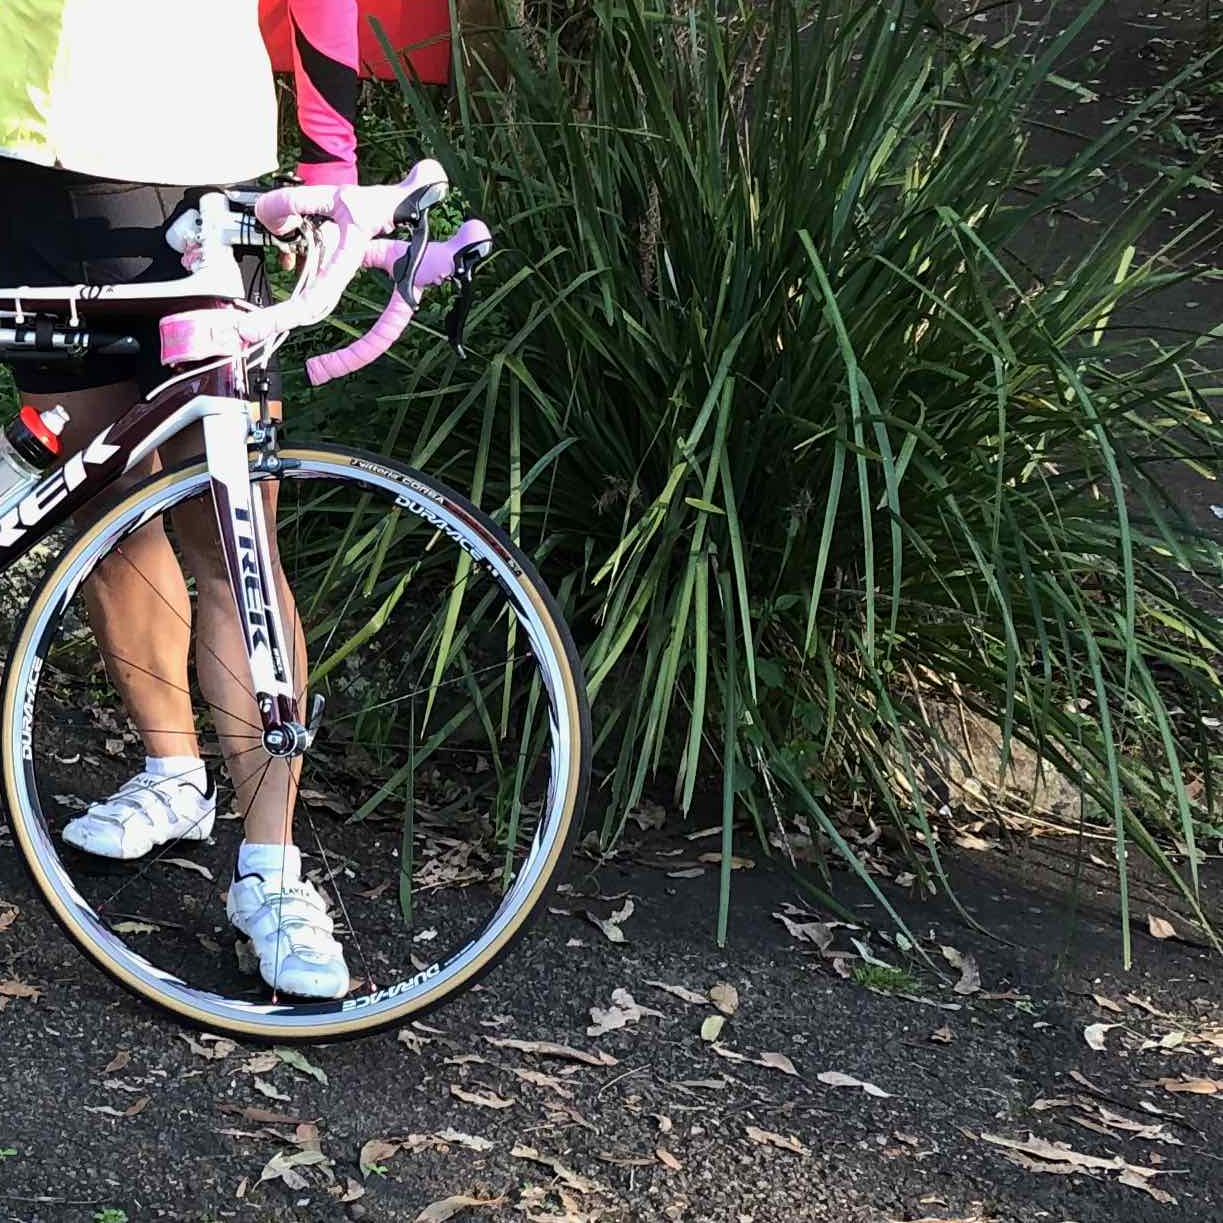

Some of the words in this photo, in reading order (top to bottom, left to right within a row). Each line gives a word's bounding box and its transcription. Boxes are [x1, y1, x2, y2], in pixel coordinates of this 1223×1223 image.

[394, 494, 483, 562] DURA-ACE
[235, 508, 267, 652] TREK
[22, 655, 44, 760] DURA-ACE
[342, 962, 441, 1012] DURA-ACE
